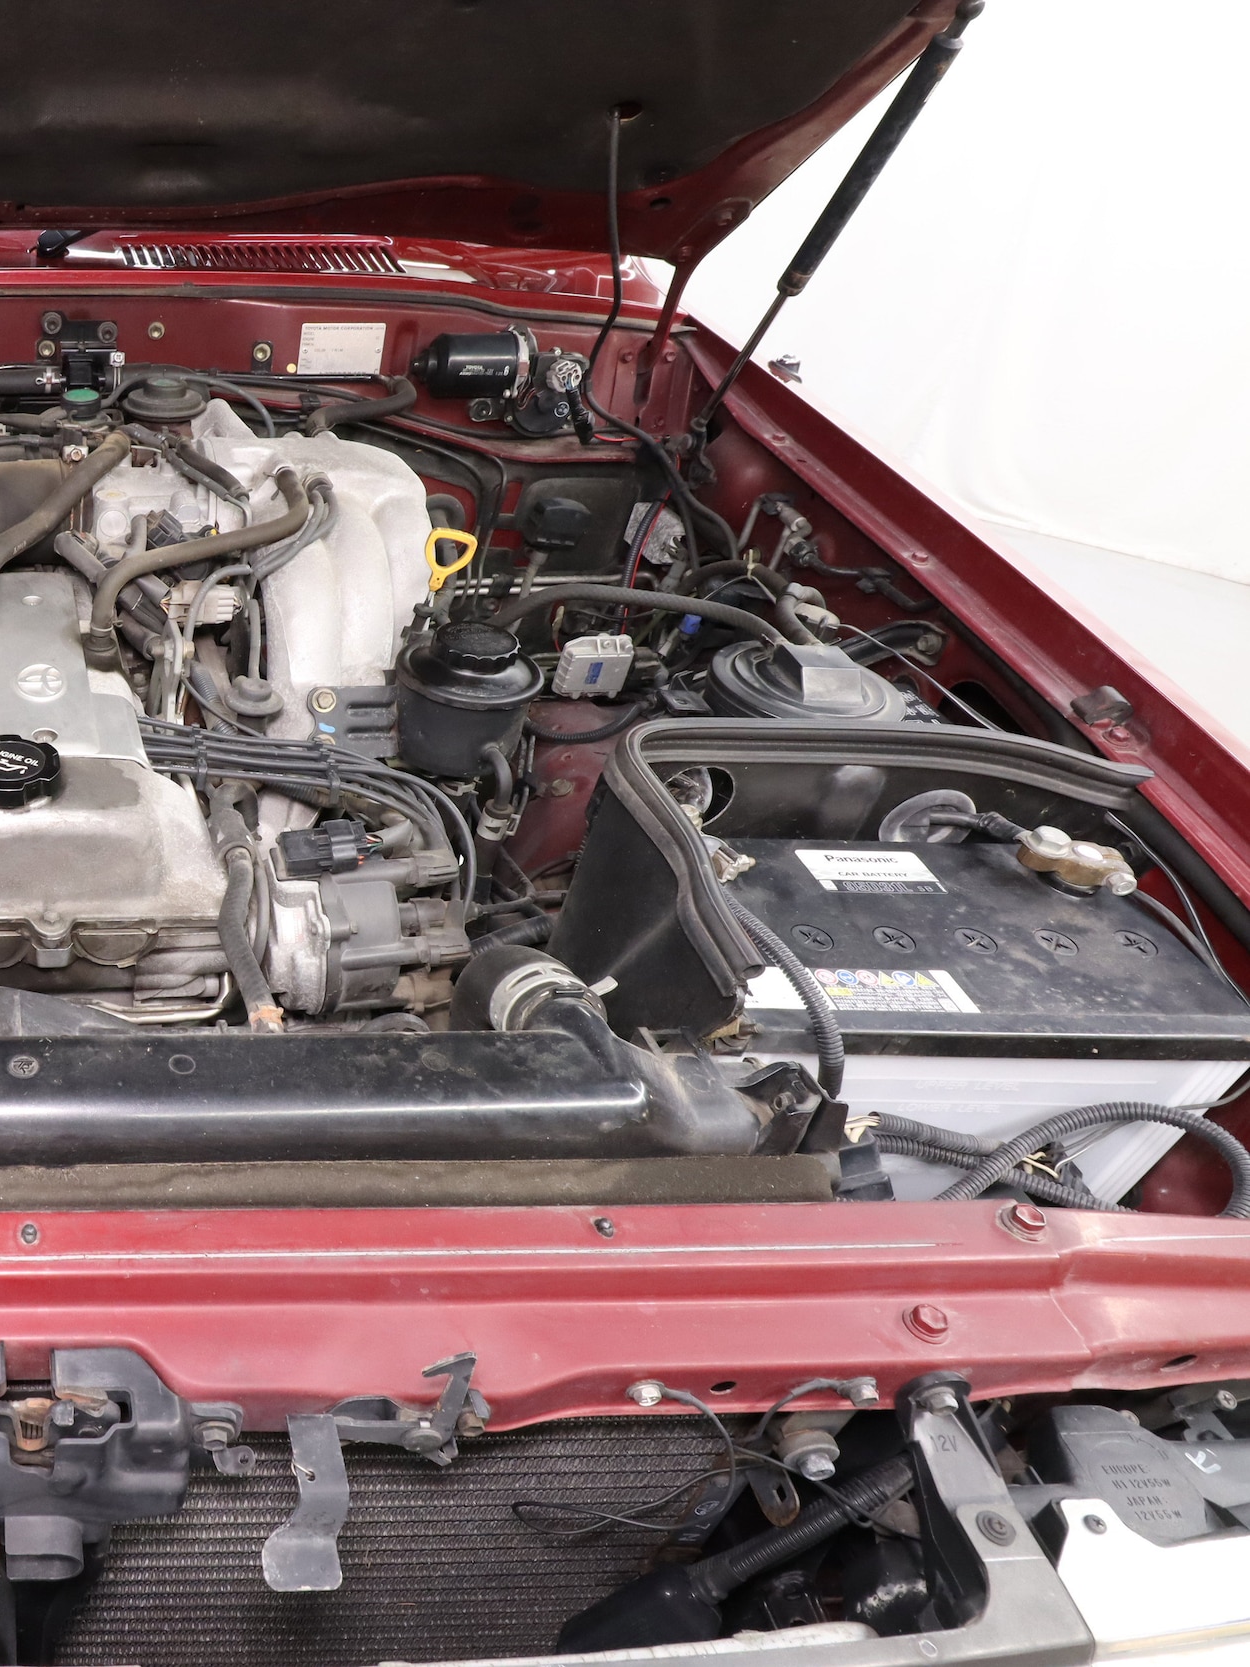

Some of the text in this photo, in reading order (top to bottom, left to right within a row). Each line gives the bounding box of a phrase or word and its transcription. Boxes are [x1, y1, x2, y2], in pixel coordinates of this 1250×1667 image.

[23, 757, 39, 767] OIL
[824, 854, 899, 864] Panasonic
[915, 1080, 1021, 1092] UPPER LEVEL
[896, 1103, 1001, 1114] LOWER LEVEL
[928, 1431, 958, 1452] 12V
